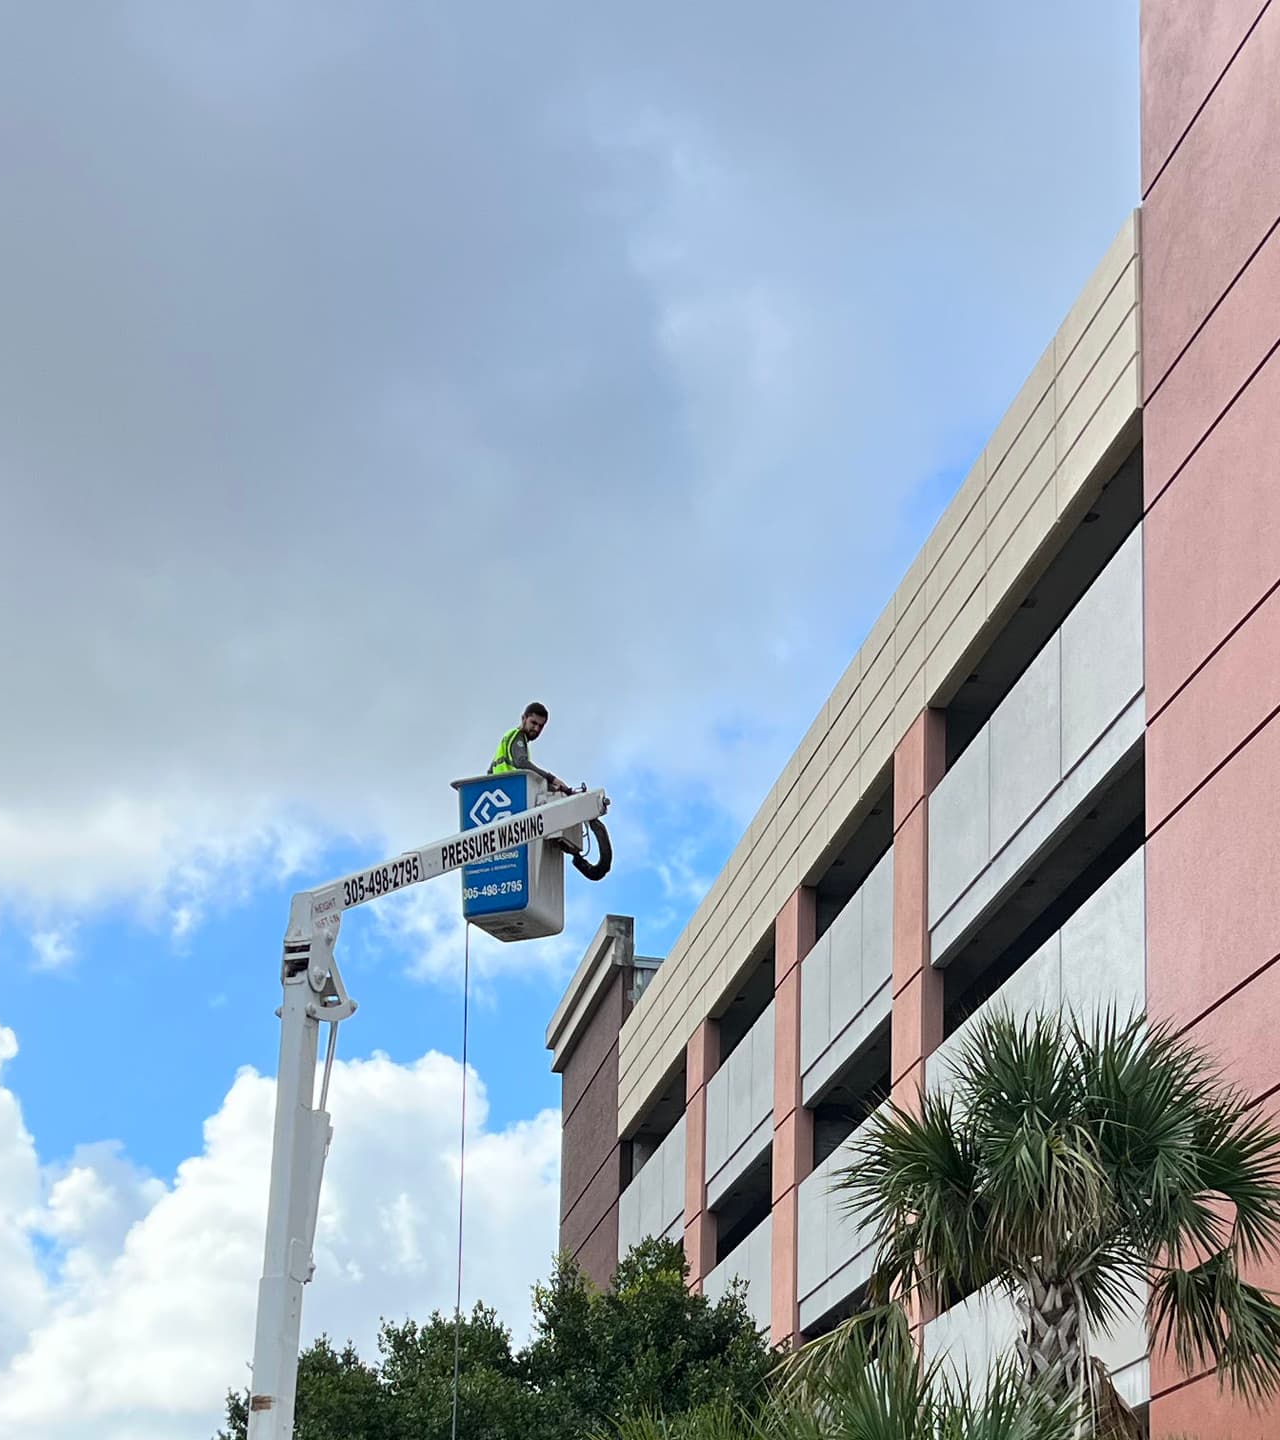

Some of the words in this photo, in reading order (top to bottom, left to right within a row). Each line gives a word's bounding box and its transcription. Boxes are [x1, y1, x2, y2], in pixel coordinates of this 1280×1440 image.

[441, 829, 497, 870] PRESSURE
[498, 813, 544, 849] WASHING
[343, 857, 420, 907] 305-498-2795
